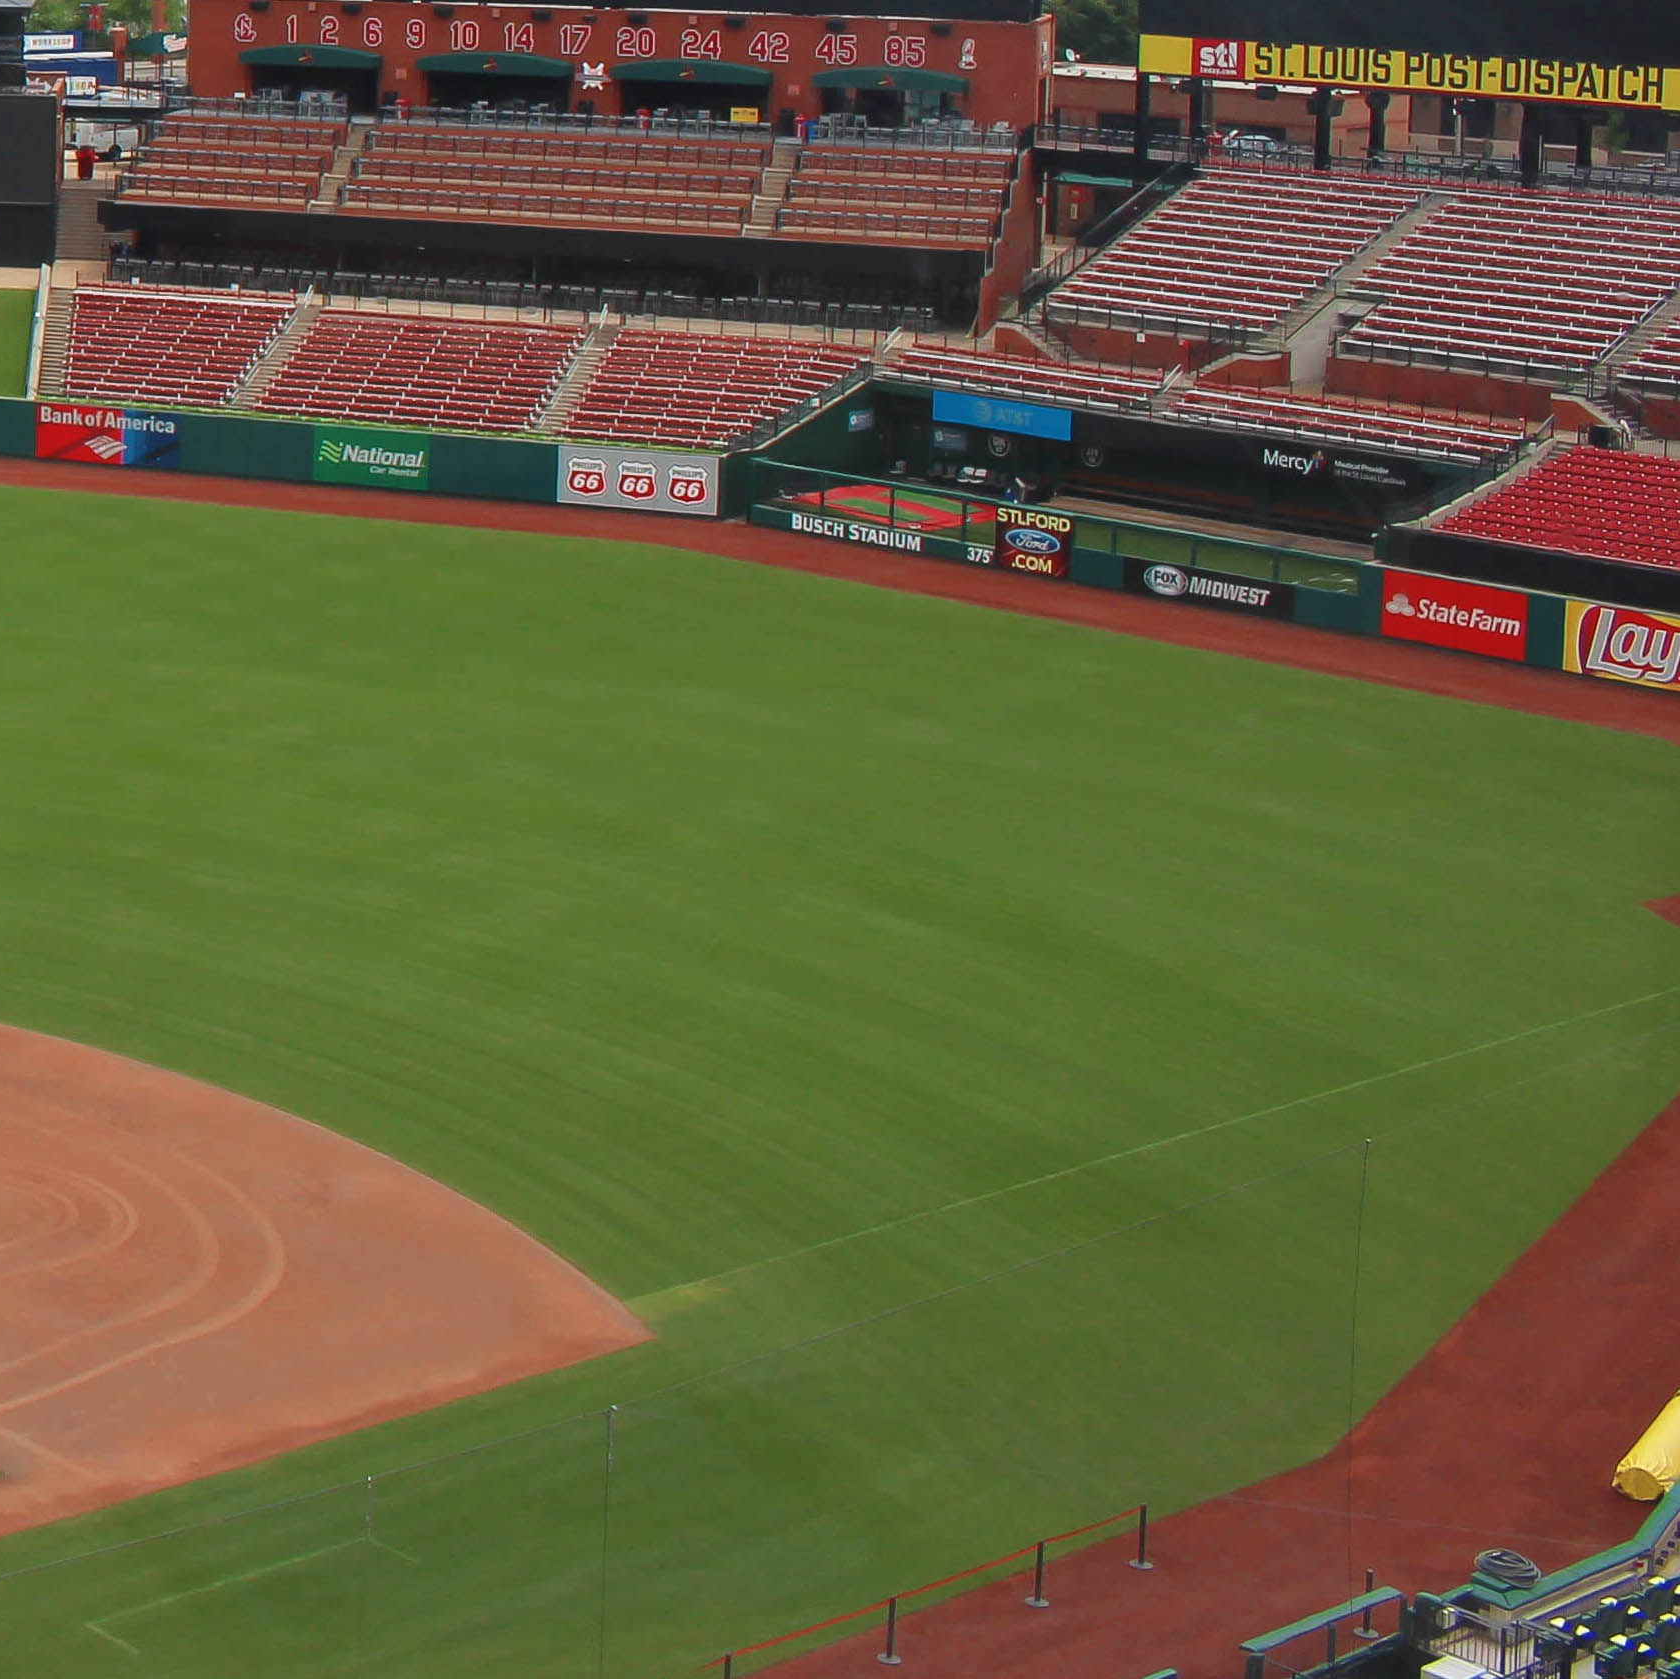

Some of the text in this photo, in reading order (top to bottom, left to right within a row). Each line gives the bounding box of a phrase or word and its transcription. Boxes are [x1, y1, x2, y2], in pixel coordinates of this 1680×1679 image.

[286, 14, 297, 44] 1
[320, 16, 339, 46] 2
[363, 17, 382, 48] 6
[406, 19, 426, 49] 9
[450, 20, 479, 51] 10
[504, 22, 534, 52] 14
[560, 24, 592, 55] 17
[616, 26, 656, 57] 20
[681, 29, 721, 60] 24
[748, 31, 790, 63] 42
[815, 33, 857, 66] 45
[884, 36, 927, 69] 85
[1199, 42, 1238, 68] stl
[1254, 41, 1663, 103] ST. LOUIS POST-DISPATCH
[41, 406, 175, 434] Bank of America
[340, 444, 426, 468] National
[571, 460, 604, 471] PHILLIPS
[620, 464, 653, 475] PHILLIPS
[1263, 448, 1314, 475] Mercy
[1334, 460, 1361, 470] Medical
[369, 464, 420, 478] Car Rental
[573, 473, 600, 490] 66
[623, 477, 651, 493] 66
[671, 468, 703, 479] PHILLIPS
[673, 481, 700, 497] 66
[791, 512, 921, 552] BUSCH STADIUM
[997, 507, 1071, 533] STLFORD
[967, 547, 993, 564] 375'
[1015, 533, 1050, 551] Ford
[1011, 553, 1052, 574] .COM
[1154, 570, 1178, 586] FOX
[1189, 575, 1270, 606] MIDWEST
[1416, 598, 1520, 637] State Farm
